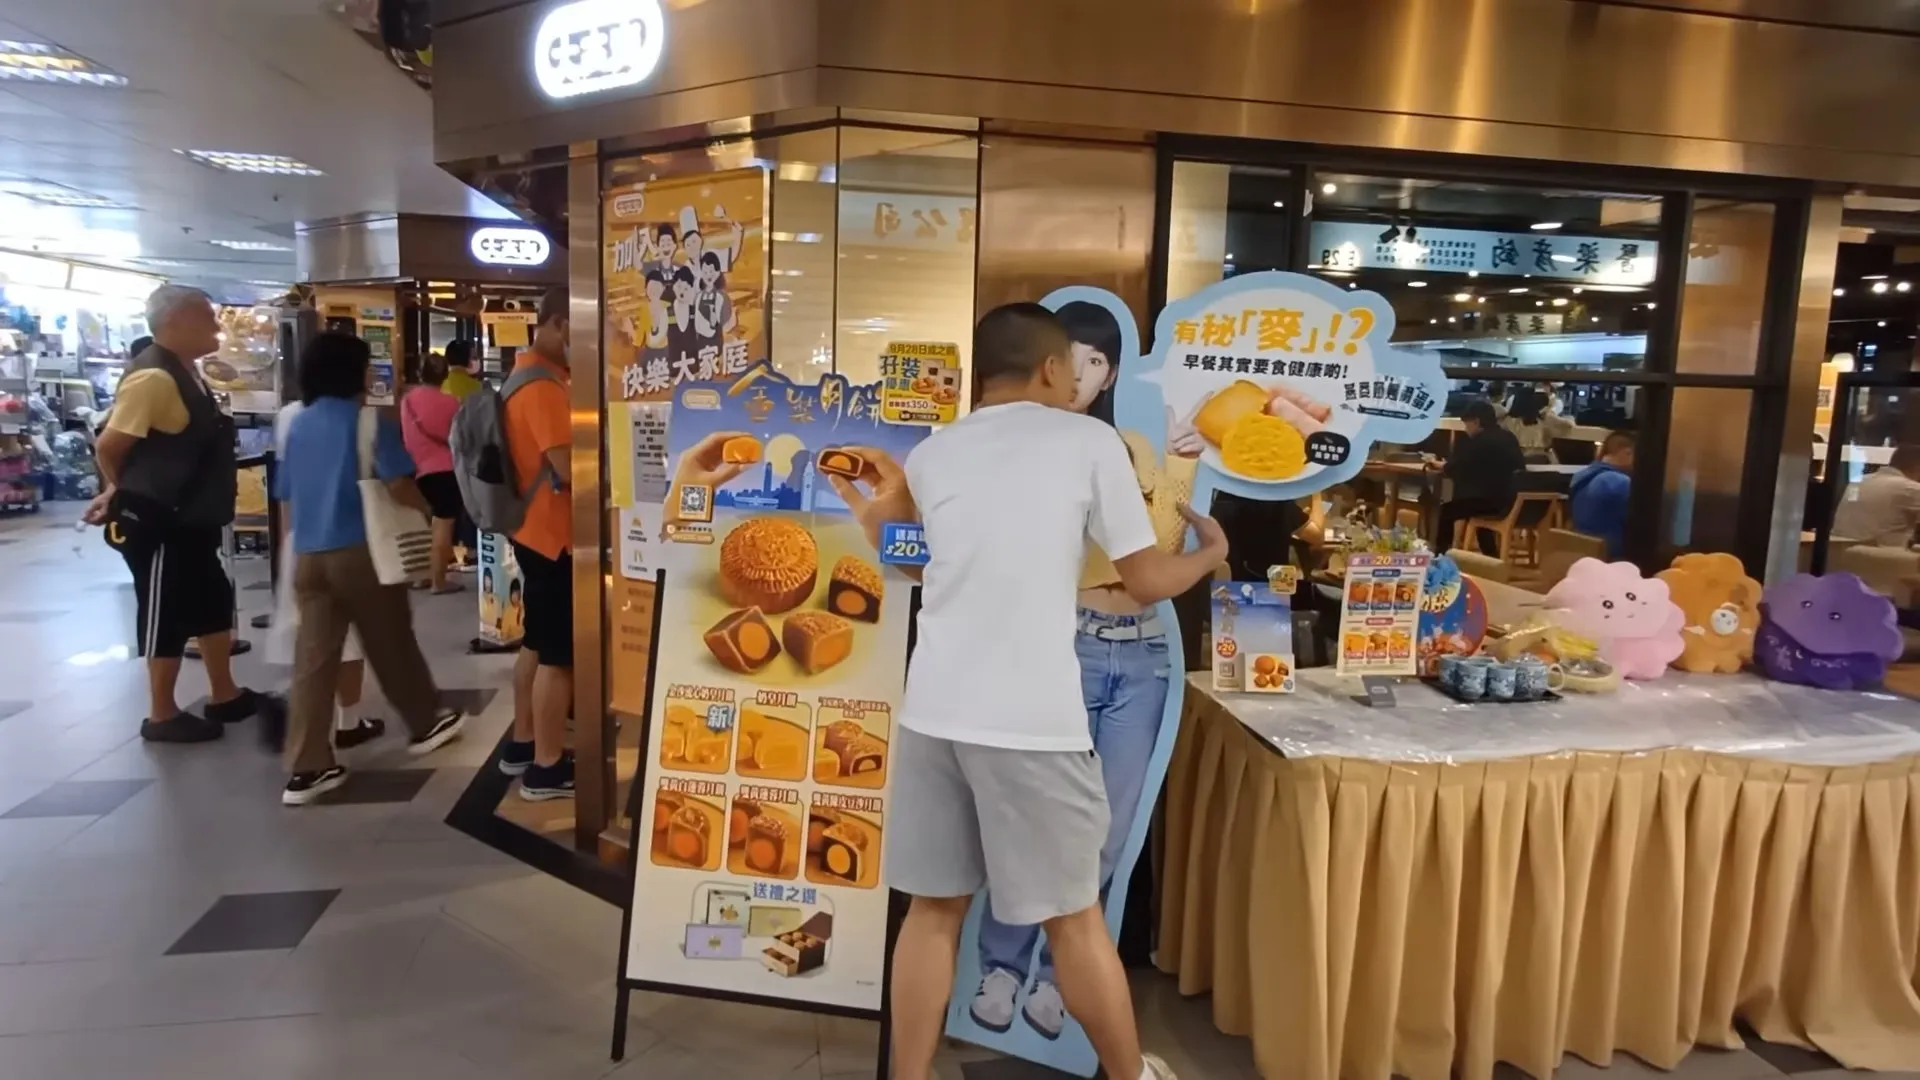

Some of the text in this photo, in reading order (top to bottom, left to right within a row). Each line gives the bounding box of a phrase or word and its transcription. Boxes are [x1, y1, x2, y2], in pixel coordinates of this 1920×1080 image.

[622, 339, 749, 398] 快樂大家庭
